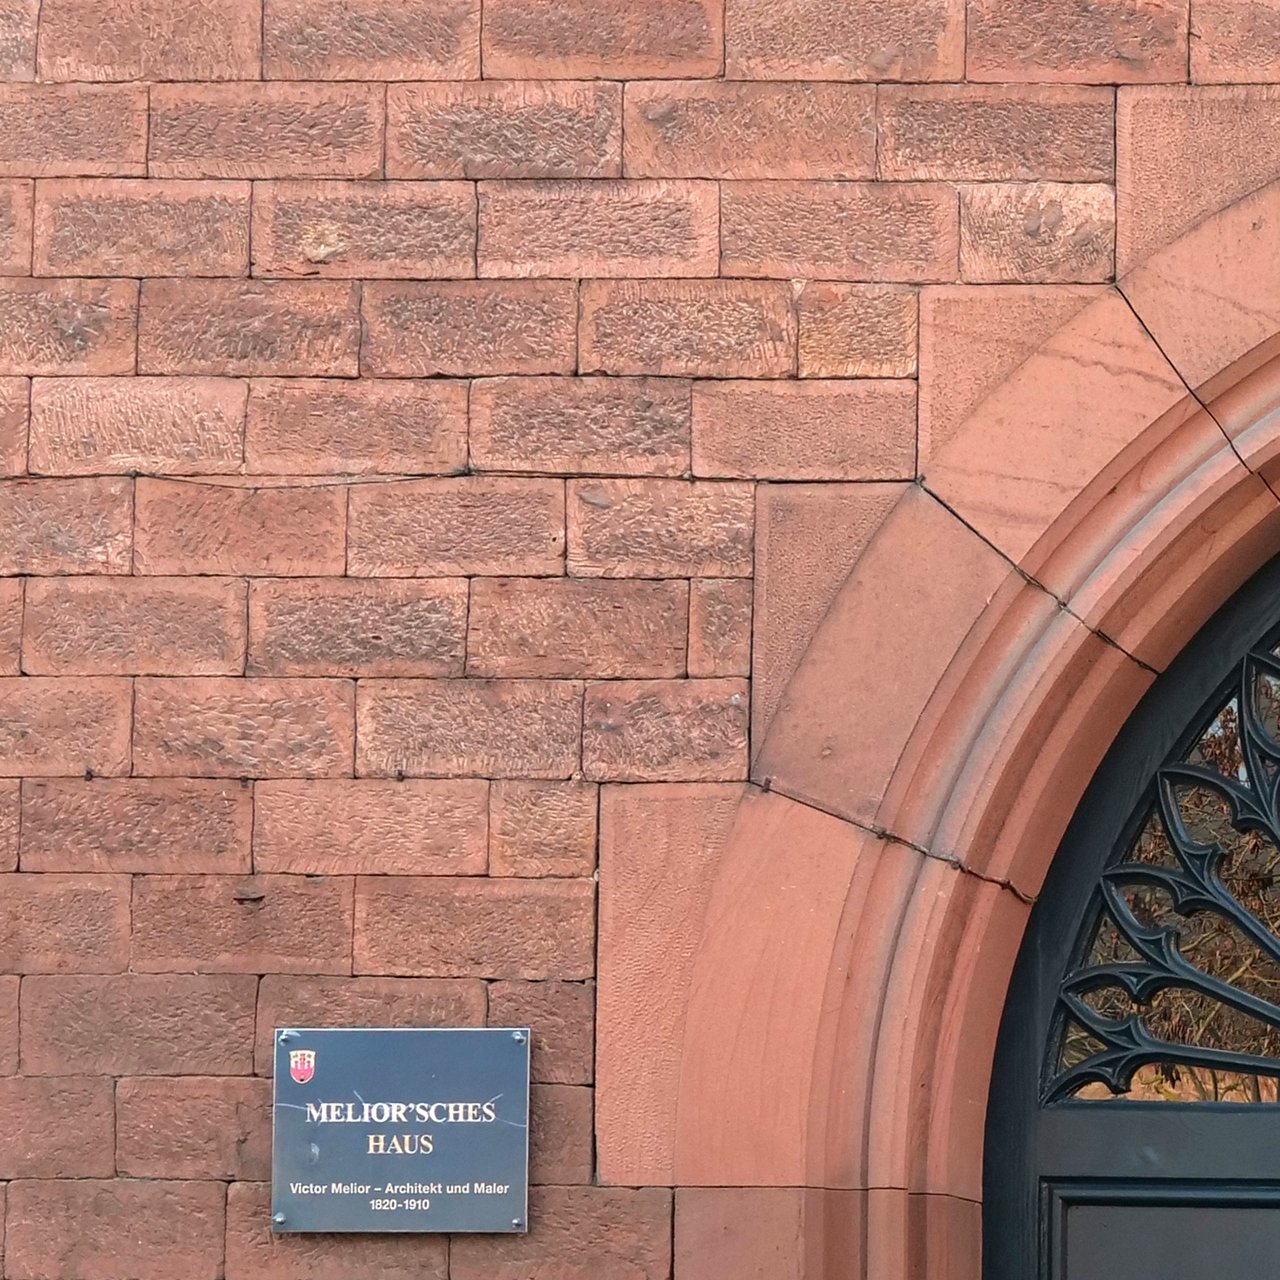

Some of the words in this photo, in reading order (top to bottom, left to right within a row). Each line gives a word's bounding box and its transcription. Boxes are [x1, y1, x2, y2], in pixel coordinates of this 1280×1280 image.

[305, 1103, 496, 1123] MELIOR’SCHES
[367, 1134, 434, 1154] HAUS
[290, 1182, 327, 1194] Victor
[331, 1182, 371, 1194] Melior
[385, 1182, 442, 1194] Architekt
[446, 1182, 470, 1194] und
[474, 1182, 510, 1194] Maler
[369, 1199, 430, 1210] 1820-1910
